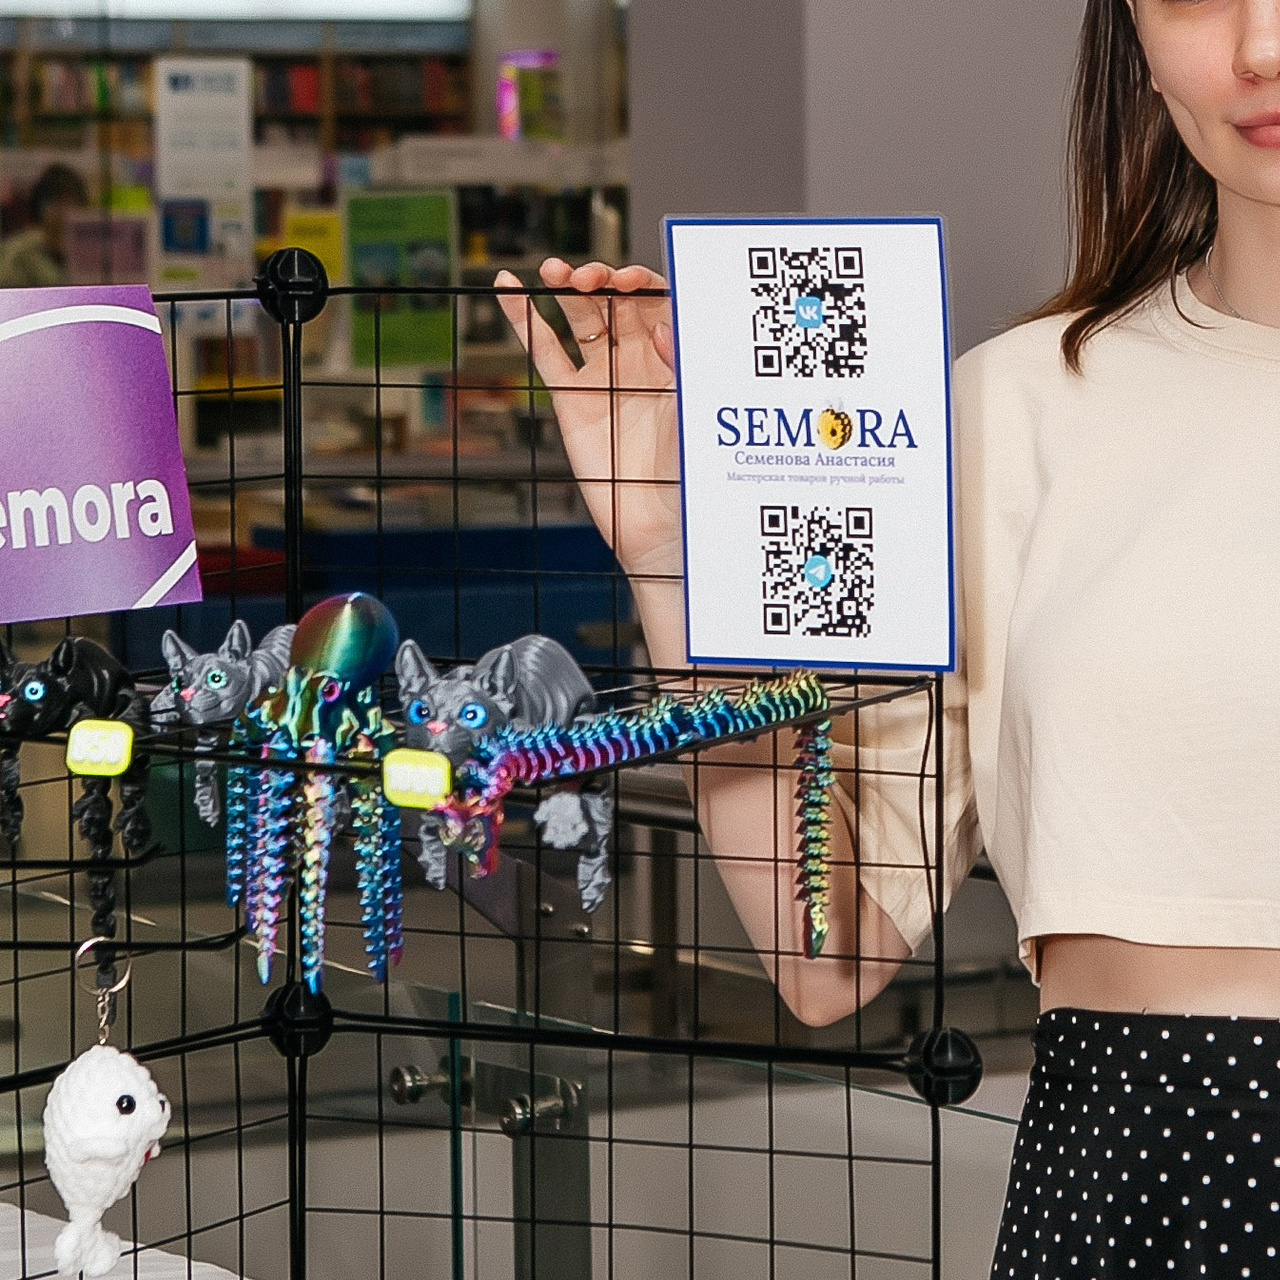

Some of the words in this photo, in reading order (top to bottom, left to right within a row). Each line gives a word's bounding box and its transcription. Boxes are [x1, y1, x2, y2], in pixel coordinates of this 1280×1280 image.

[734, 451, 810, 467] Семенова
[815, 452, 895, 468] Анастасия
[727, 471, 785, 484] Мастерская
[788, 474, 827, 486] товаров
[830, 473, 866, 487] ручной
[869, 473, 906, 487] работы
[0, 478, 174, 550] mora
